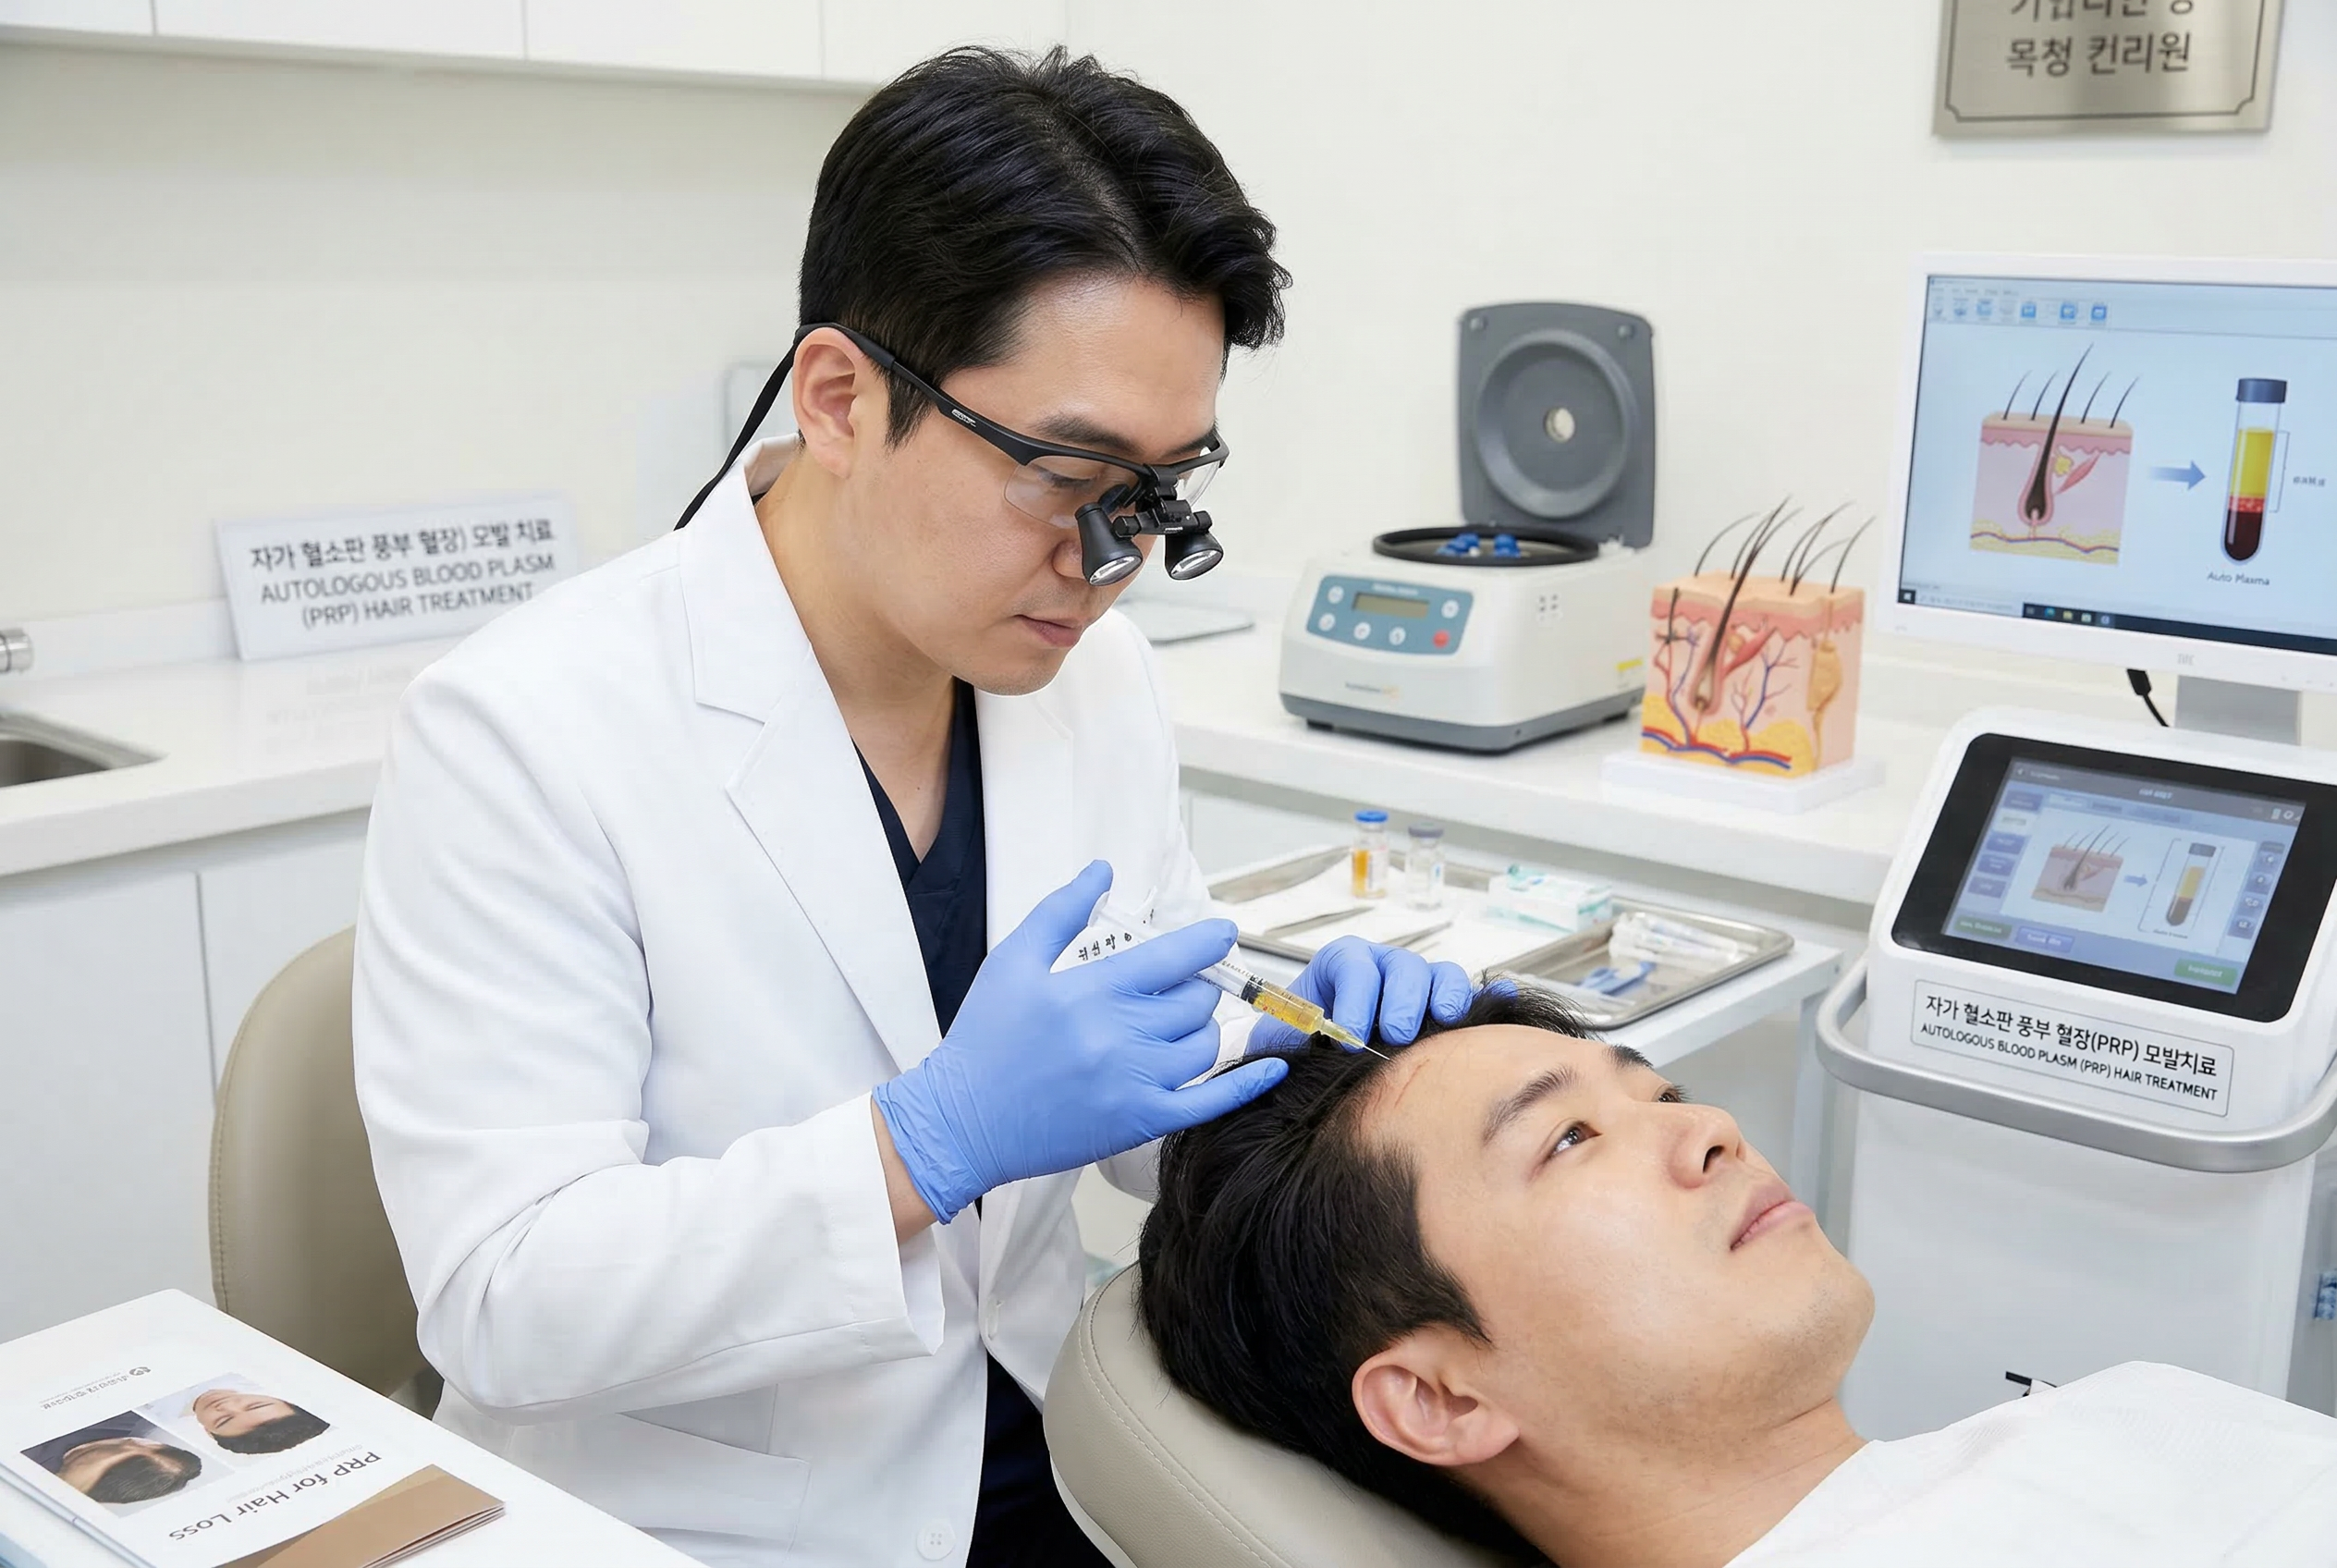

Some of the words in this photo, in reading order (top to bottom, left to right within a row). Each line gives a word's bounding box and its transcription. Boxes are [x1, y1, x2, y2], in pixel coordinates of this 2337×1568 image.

[2006, 36, 2073, 78] 목청
[251, 542, 295, 572] 자가
[301, 536, 366, 569] 혈소판
[373, 531, 414, 561] 풍부
[472, 521, 509, 548] 모발
[516, 518, 555, 544] 치료
[261, 568, 408, 605] AUTOLOGOUS
[412, 560, 483, 587] BLOOD
[487, 552, 555, 578] PLASM
[302, 600, 360, 631] (PRP)
[363, 596, 414, 620] HAIR
[417, 582, 533, 614] TREATMENT
[1926, 996, 1959, 1020] 자가
[1964, 1002, 2013, 1034] 혈소판
[2017, 1015, 2051, 1041] 풍부
[2057, 1023, 2139, 1062] 혈장(PRP)
[2143, 1044, 2217, 1077] 모발치료
[1920, 1023, 1995, 1050] AUTOLOGOUS
[1998, 1040, 2037, 1060] BLOOD
[2038, 1049, 2078, 1070] PLASM
[2080, 1059, 2111, 1079] (PRP)
[2114, 1067, 2143, 1084] HAIR
[2145, 1073, 2218, 1101] TREATMENT
[293, 1473, 328, 1493] for
[334, 1452, 382, 1477] PRP
[237, 1489, 290, 1516] Hair
[168, 1513, 232, 1541] Loss
